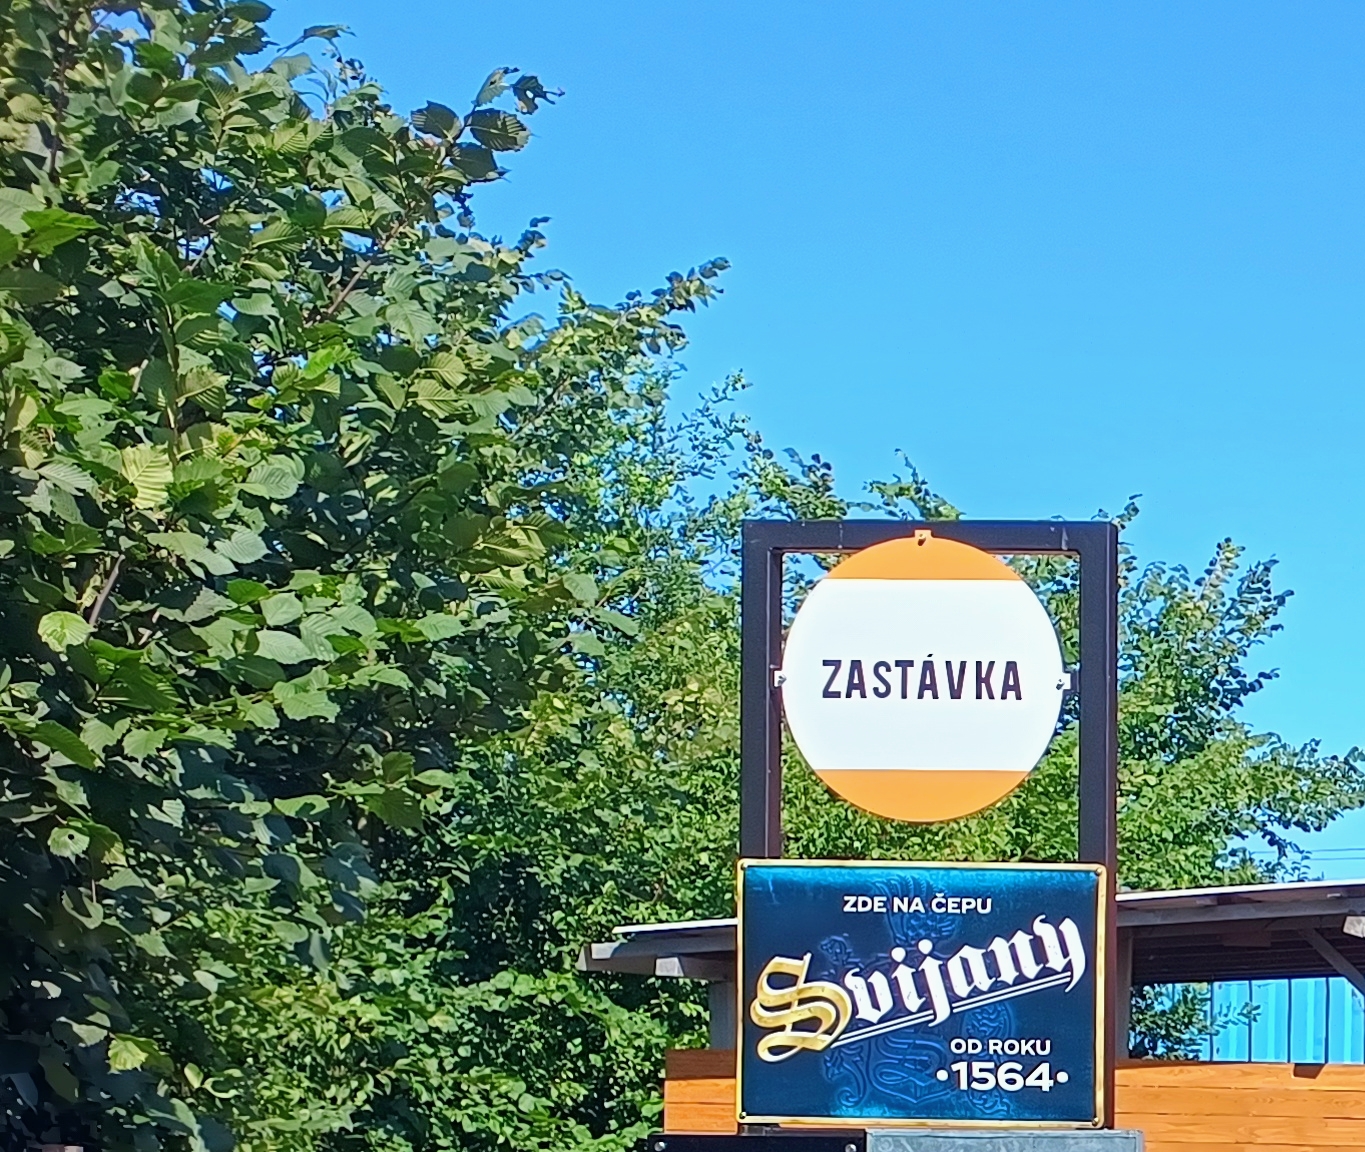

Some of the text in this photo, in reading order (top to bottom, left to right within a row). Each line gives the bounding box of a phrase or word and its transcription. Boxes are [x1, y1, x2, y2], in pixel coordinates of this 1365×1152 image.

[821, 653, 1022, 700] ZASTÁVKA
[843, 893, 992, 915] ZDE NA ČEPU
[750, 914, 1086, 1063] Svijany
[950, 1039, 1051, 1056] OD ROKU
